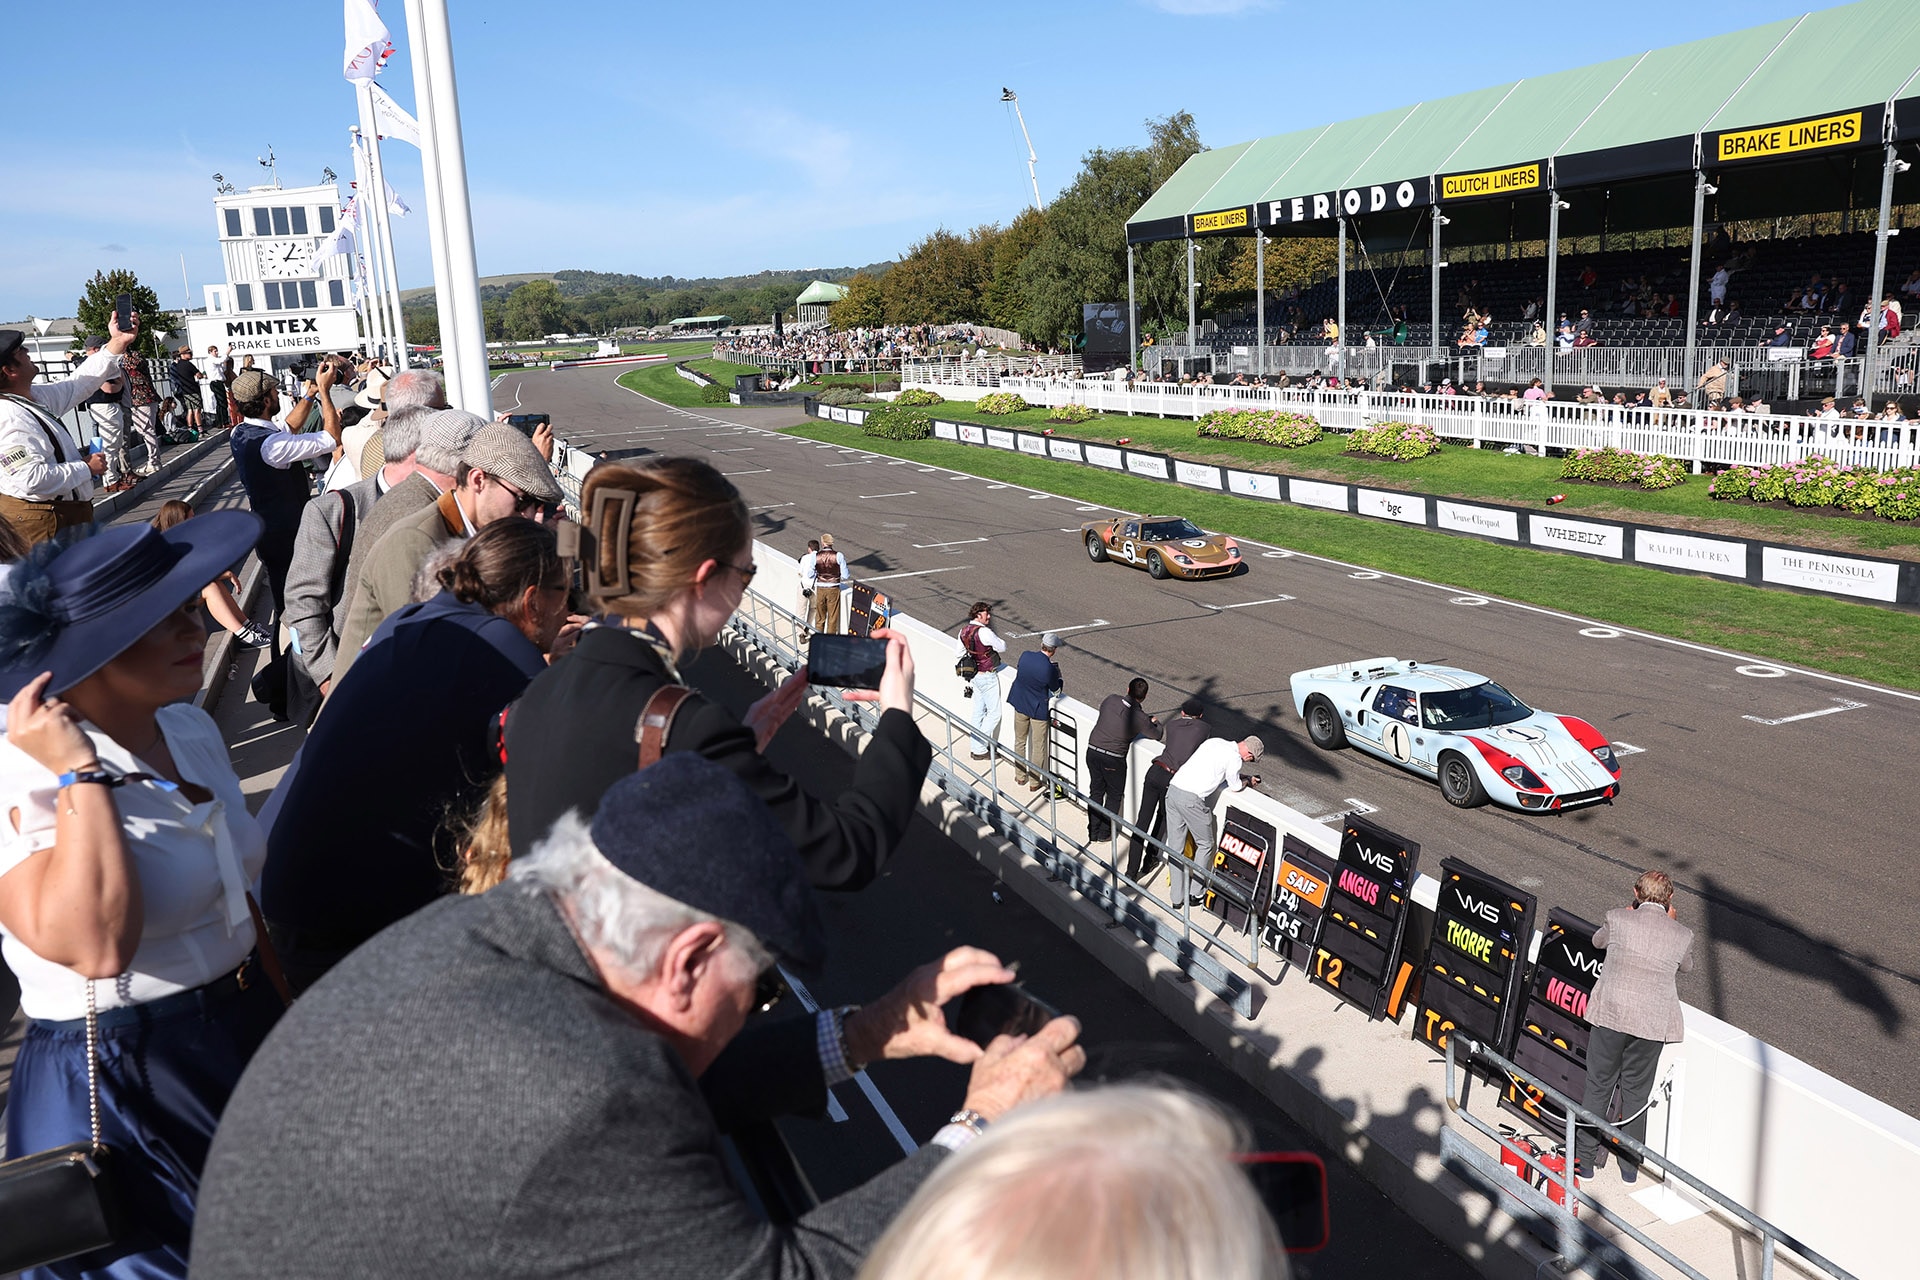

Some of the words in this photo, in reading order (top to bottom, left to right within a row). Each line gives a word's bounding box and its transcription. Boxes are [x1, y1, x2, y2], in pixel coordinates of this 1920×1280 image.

[1724, 131, 1781, 155] BRAKE
[1789, 119, 1855, 147] LINERS
[1446, 177, 1489, 194] CLUTCH
[1494, 169, 1536, 189] LINERS
[1269, 181, 1415, 226] FERODO
[1195, 216, 1218, 230] BRAKE
[1221, 212, 1245, 225] LINERS
[257, 243, 267, 276] ROLEX
[226, 318, 318, 336] MINTEX
[231, 339, 271, 350] BRAKE
[276, 336, 321, 347] LINERS
[1053, 447, 1077, 456] ALPINE
[1387, 501, 1402, 516] bgc
[1452, 511, 1471, 523] Veuve
[1471, 514, 1501, 529] Clicquot
[1125, 544, 1133, 561] 5
[1648, 543, 1683, 556] RALPH
[1687, 549, 1731, 563] LAUREN
[1781, 557, 1804, 569] THE
[1808, 560, 1875, 579] PENINSULA
[1391, 725, 1404, 761] 1
[1506, 728, 1539, 741] 1
[1213, 851, 1225, 869] P
[1219, 832, 1262, 867] HOLME
[1286, 870, 1319, 896] SAIF
[1338, 868, 1380, 906] ANGUS
[1205, 889, 1216, 909] T
[1447, 919, 1495, 964] THORPE
[1316, 948, 1343, 988] T2
[1424, 1008, 1456, 1051] T2
[1508, 1071, 1545, 1119] T2
